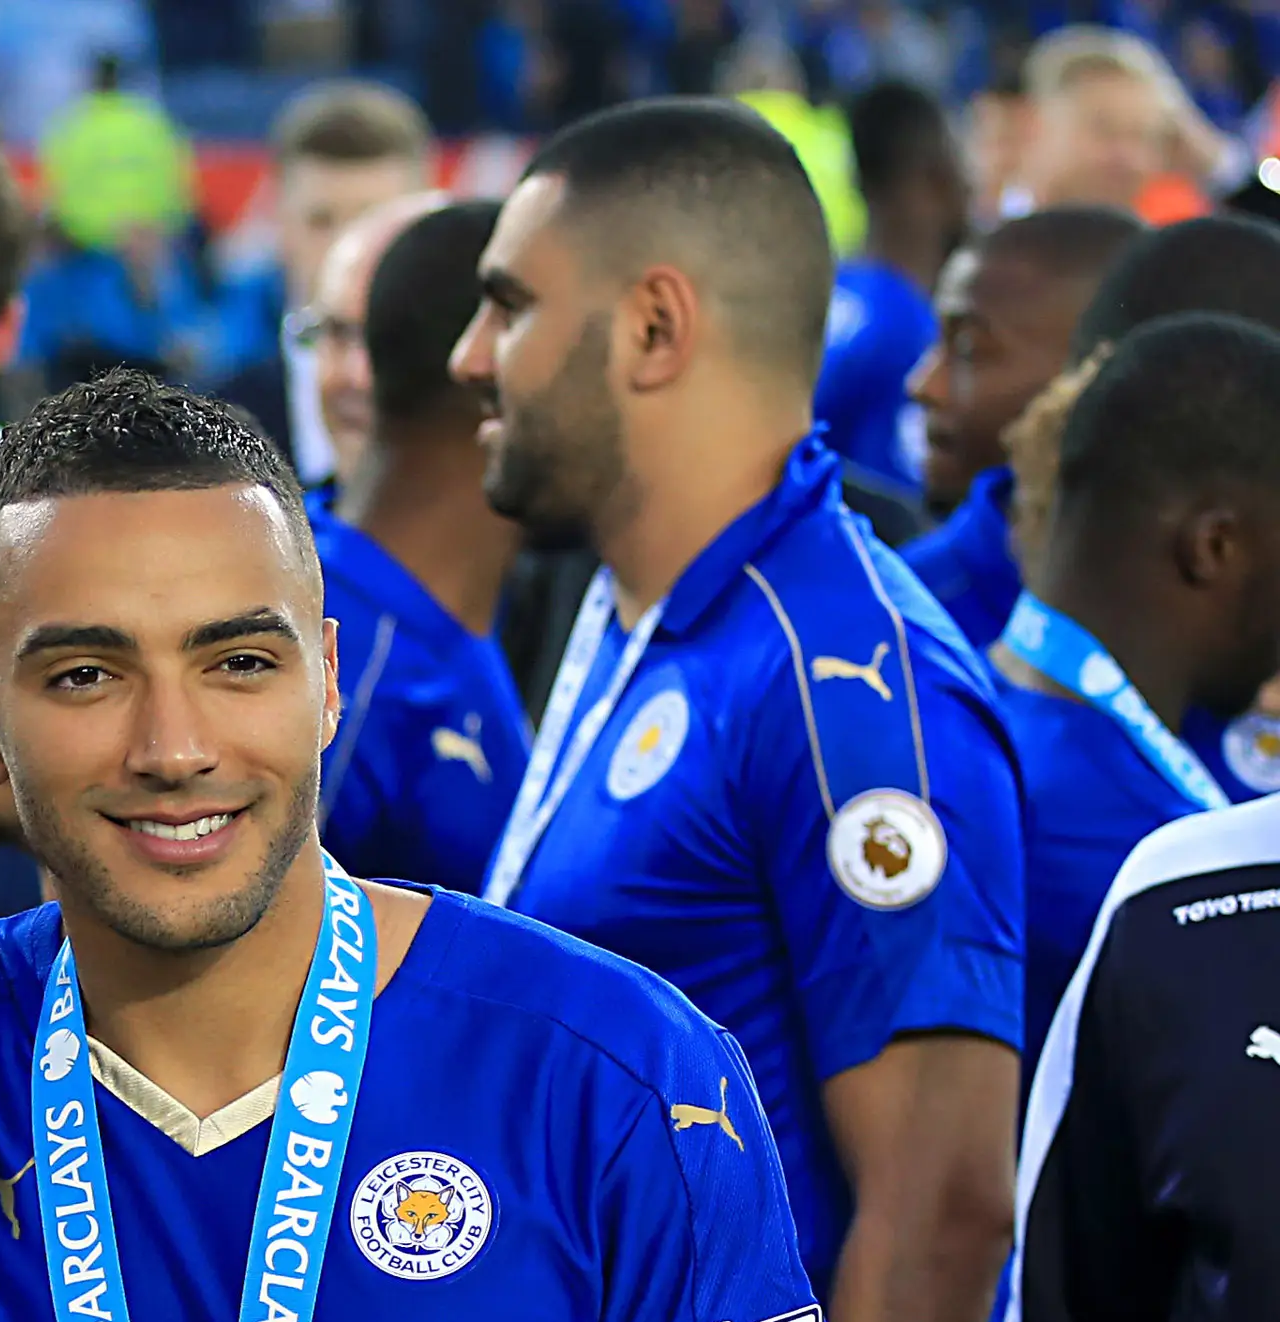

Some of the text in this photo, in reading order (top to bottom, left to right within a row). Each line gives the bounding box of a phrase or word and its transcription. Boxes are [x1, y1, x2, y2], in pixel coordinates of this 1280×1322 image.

[310, 847, 365, 1052] ARCLAYS
[361, 1157, 485, 1215] LEICESTER CITY
[357, 1215, 482, 1273] FOOTBALL CLUB
